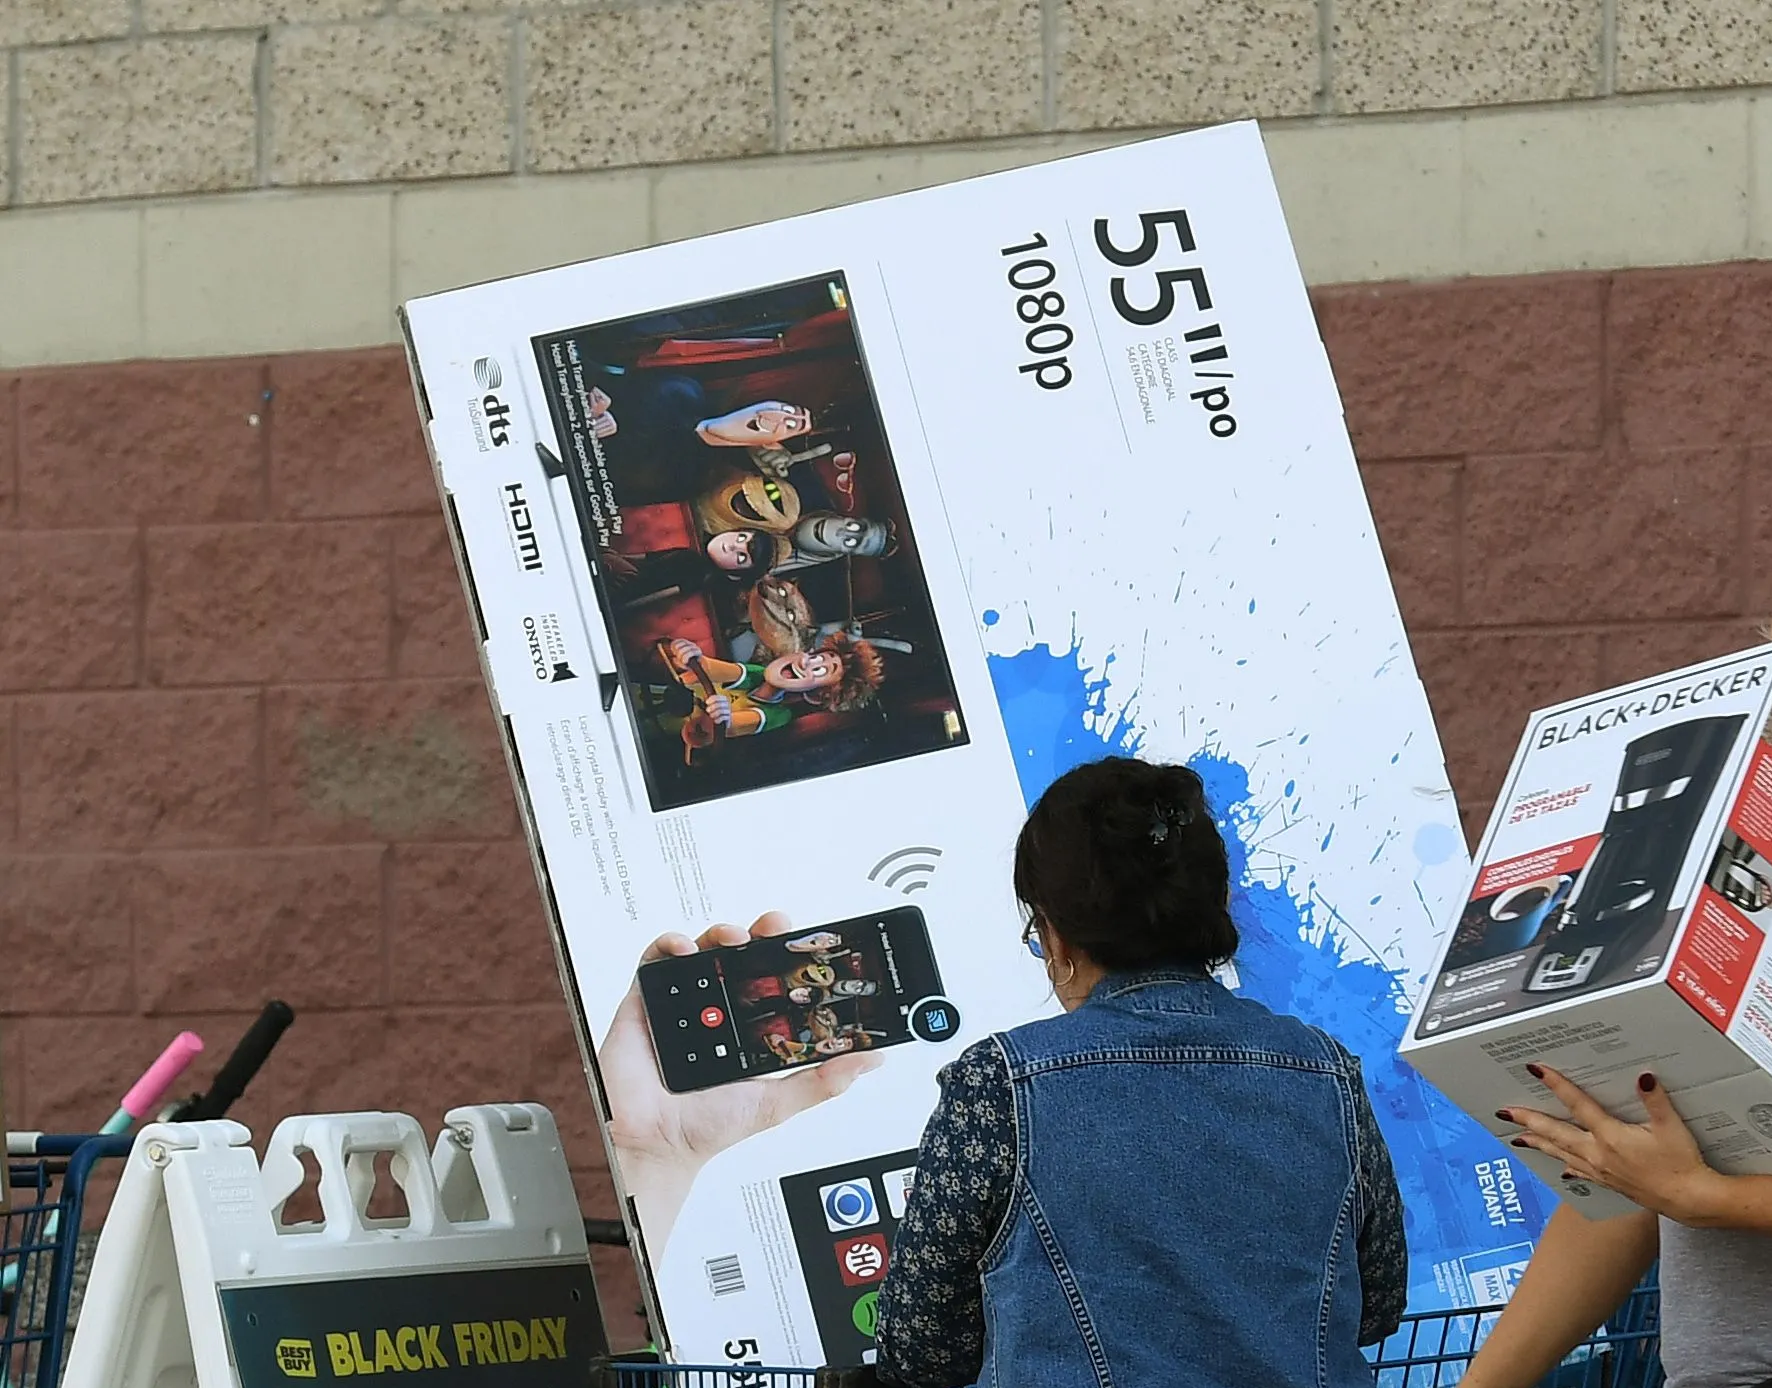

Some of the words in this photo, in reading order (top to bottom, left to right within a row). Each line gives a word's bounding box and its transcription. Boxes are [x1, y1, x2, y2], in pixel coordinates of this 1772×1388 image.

[1001, 232, 1074, 390] 1080p
[548, 342, 565, 368] Hotel
[564, 339, 581, 364] Hotel
[1163, 336, 1178, 363] CLASS
[1157, 357, 1176, 401] DIAGONAL
[1133, 376, 1154, 424] DIAGONALE
[465, 396, 490, 453] TruSurround
[481, 394, 511, 448] dts
[586, 493, 606, 528] Google
[600, 481, 619, 515] Google
[504, 482, 542, 571] HDMI
[595, 528, 611, 548] Play
[609, 515, 624, 535] Play
[522, 616, 548, 681] ONKYO
[539, 614, 558, 662] INSTALLED
[547, 612, 565, 656] SPEAKER
[1537, 665, 1768, 750] BLACK+DECKER
[576, 715, 594, 743] Liquid
[583, 743, 602, 775] Crystal
[592, 776, 611, 809] Display
[568, 820, 583, 838] DEL
[601, 810, 616, 829] with
[606, 830, 624, 859] Direct
[613, 859, 629, 879] LED
[618, 880, 640, 921] Backlight
[1474, 1161, 1506, 1229] DEVANT
[1492, 1157, 1521, 1213] FRONT
[1483, 1273, 1502, 1301] MAX
[279, 1344, 311, 1360] BEST
[326, 1323, 449, 1376] BLACK
[453, 1316, 567, 1367] FRIDAY
[283, 1356, 311, 1373] BUY
